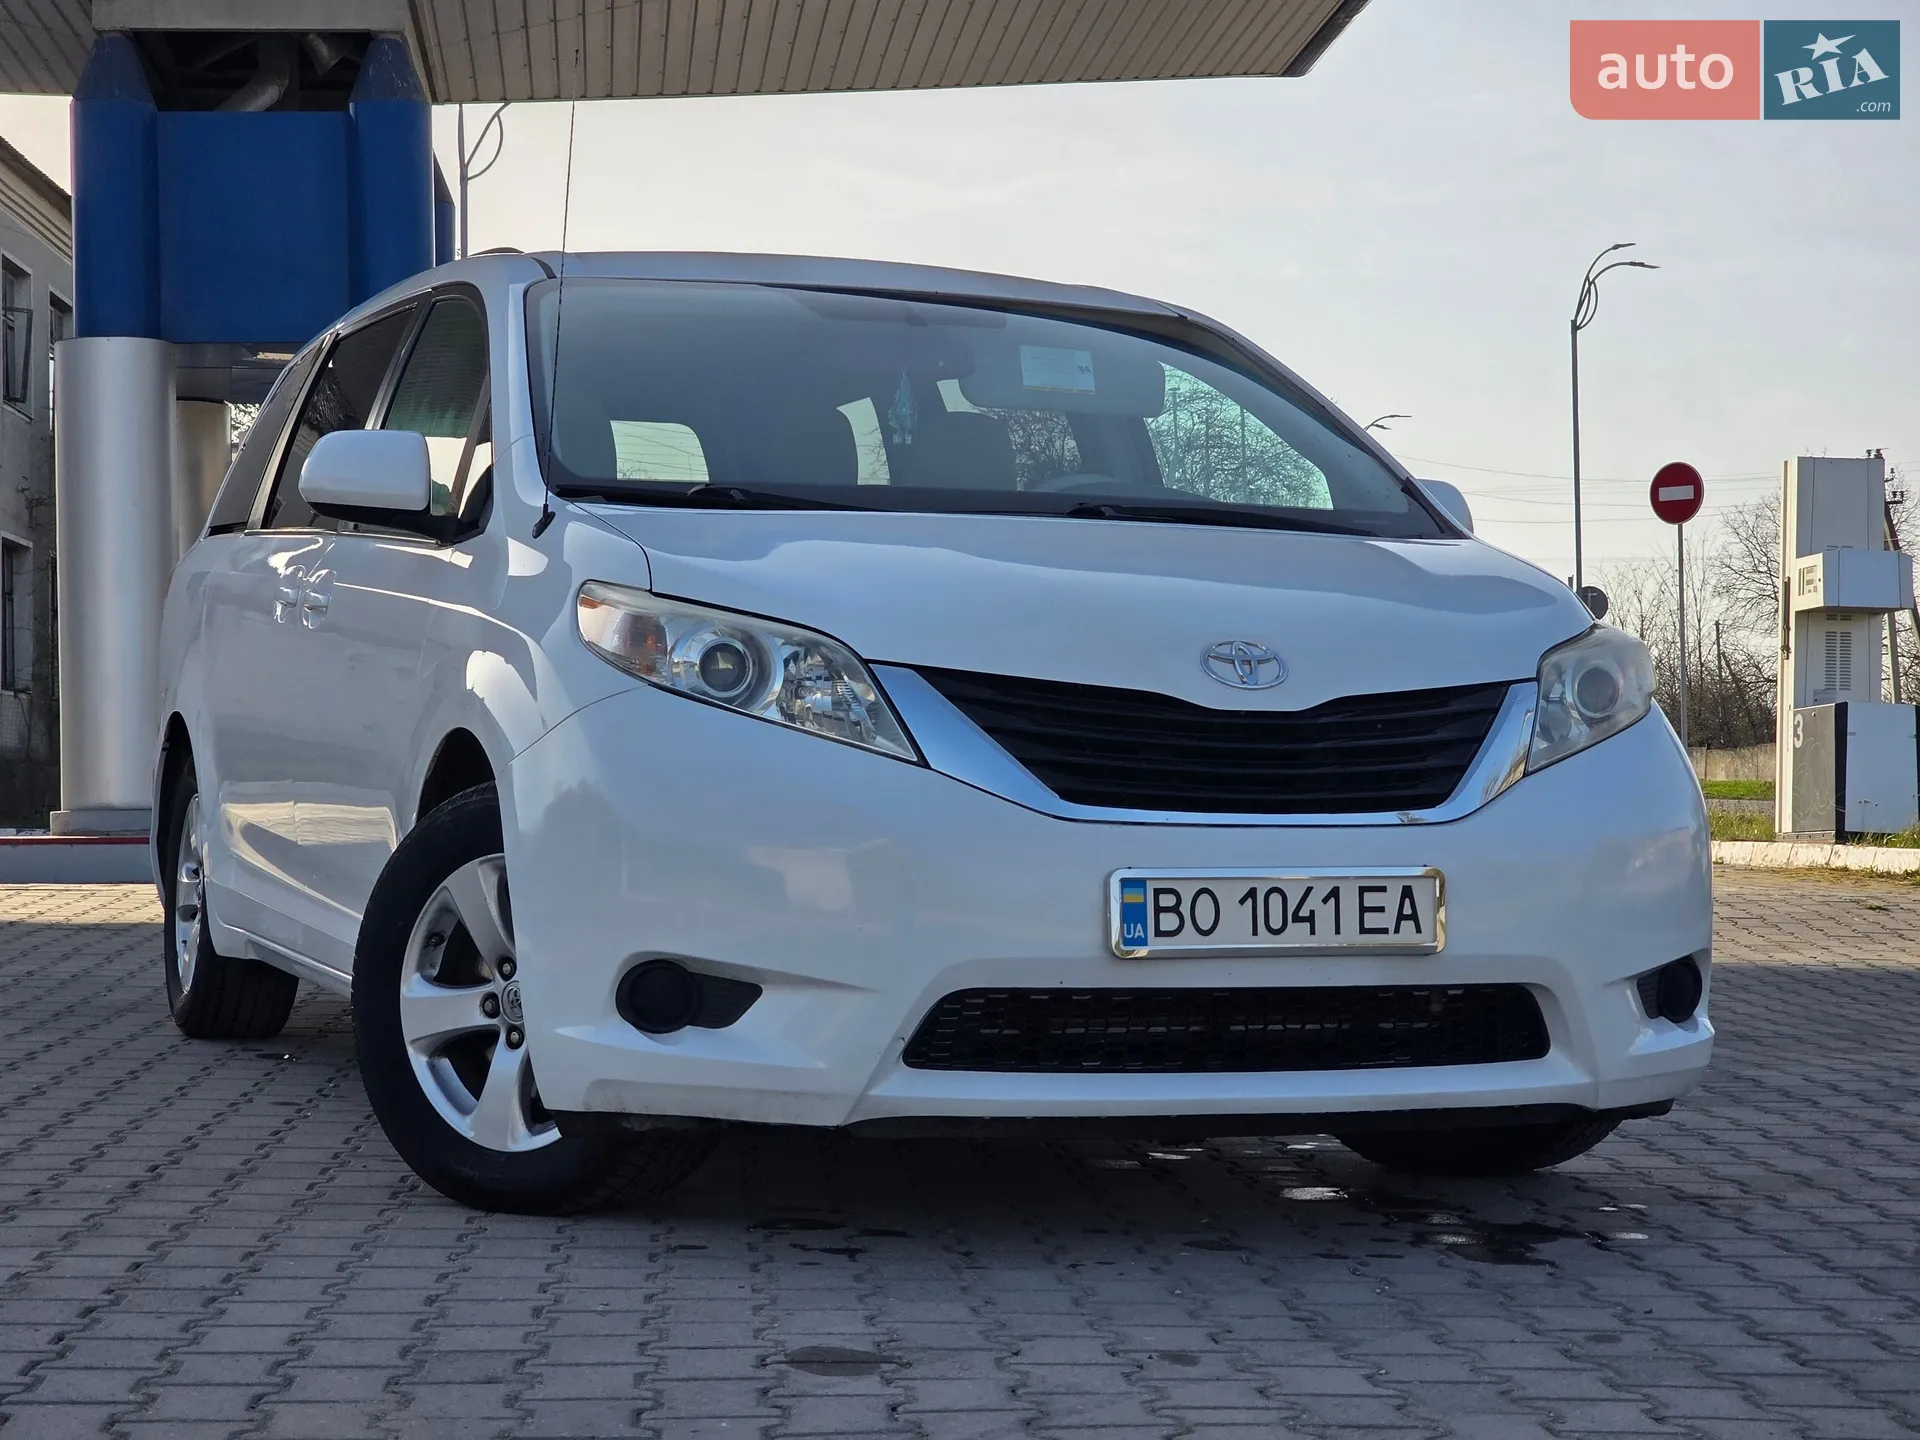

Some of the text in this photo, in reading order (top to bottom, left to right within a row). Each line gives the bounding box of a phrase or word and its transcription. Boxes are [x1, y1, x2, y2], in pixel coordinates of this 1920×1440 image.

[1794, 713, 1804, 748] 3
[1153, 884, 1422, 938] BO 1041 EA
[1123, 924, 1145, 939] UA
